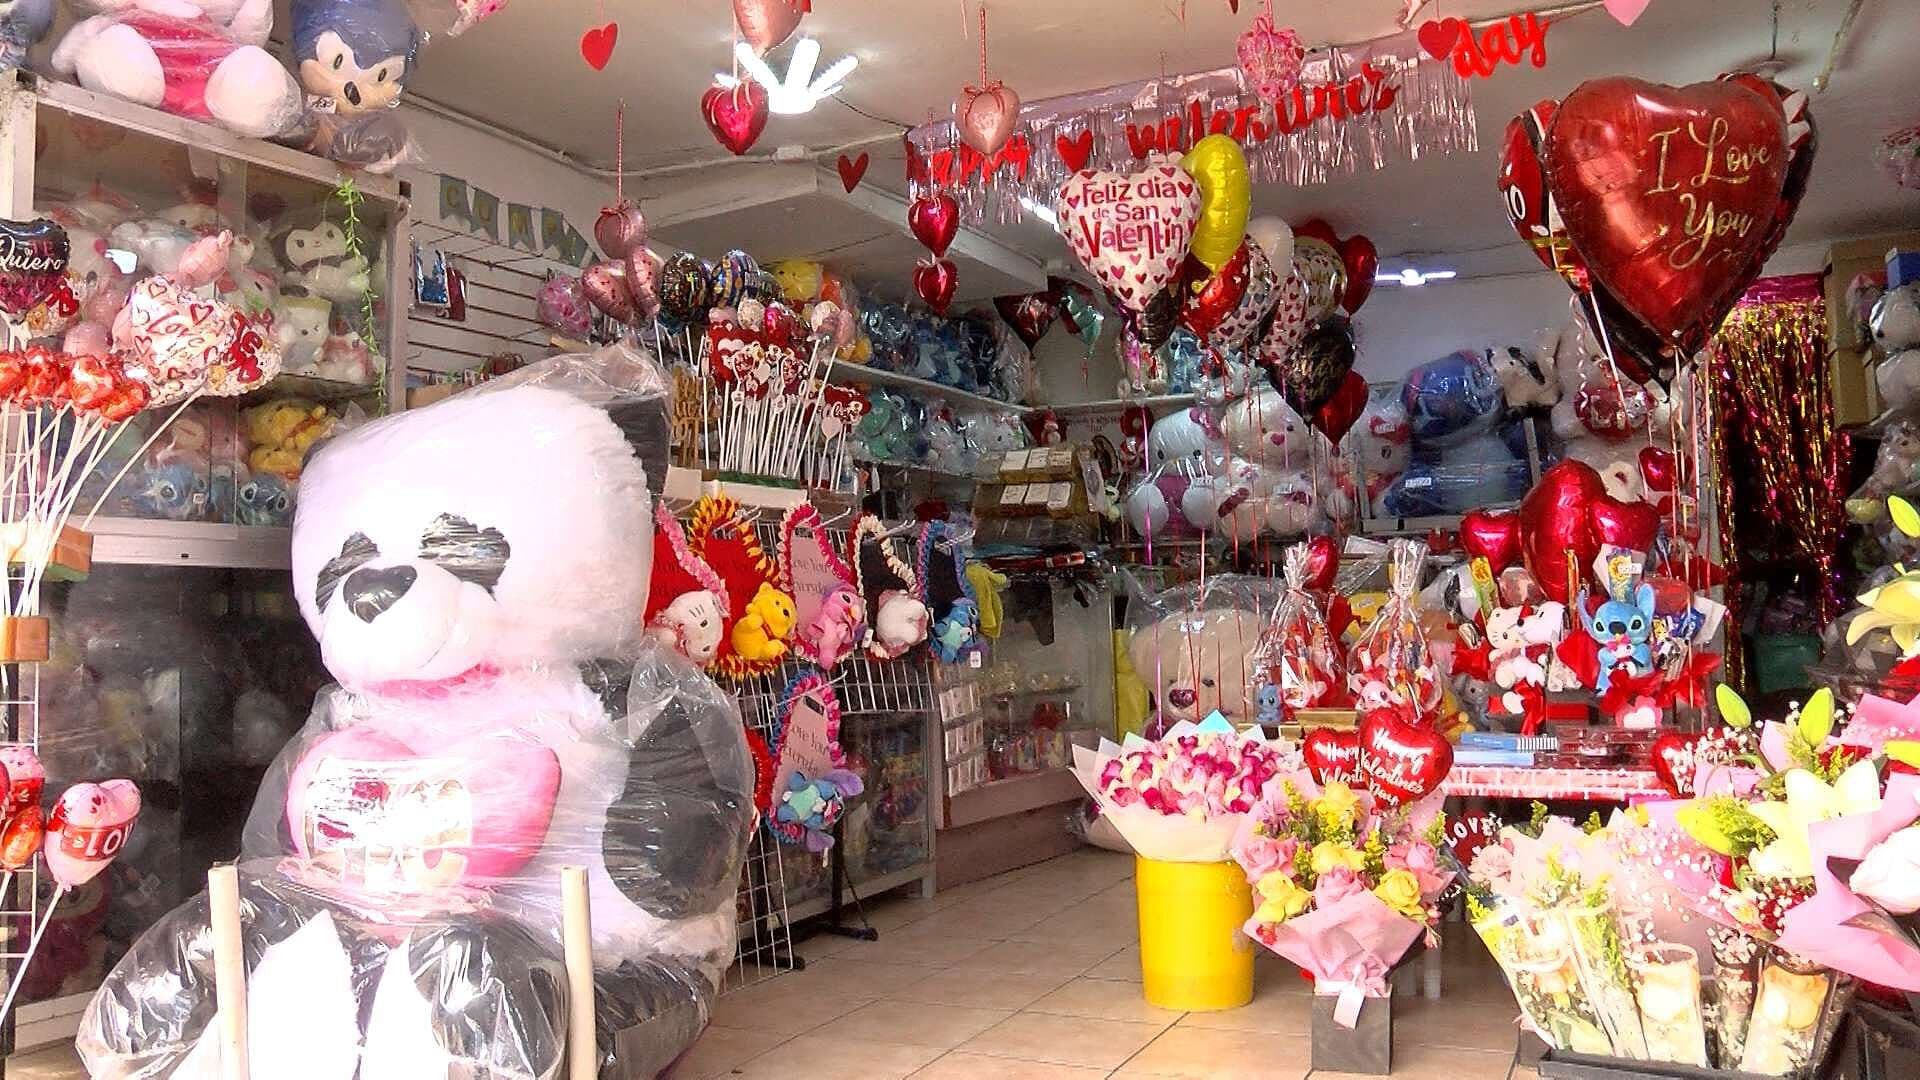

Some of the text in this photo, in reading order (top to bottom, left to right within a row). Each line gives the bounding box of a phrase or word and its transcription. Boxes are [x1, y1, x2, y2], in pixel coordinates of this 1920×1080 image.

[1452, 10, 1551, 79] day
[1644, 116, 1772, 196] I Love
[1081, 179, 1132, 208] Feliz
[1115, 203, 1159, 222] San
[0, 232, 62, 272] Quiero
[1079, 215, 1184, 260] Valentin
[1669, 192, 1755, 271] You
